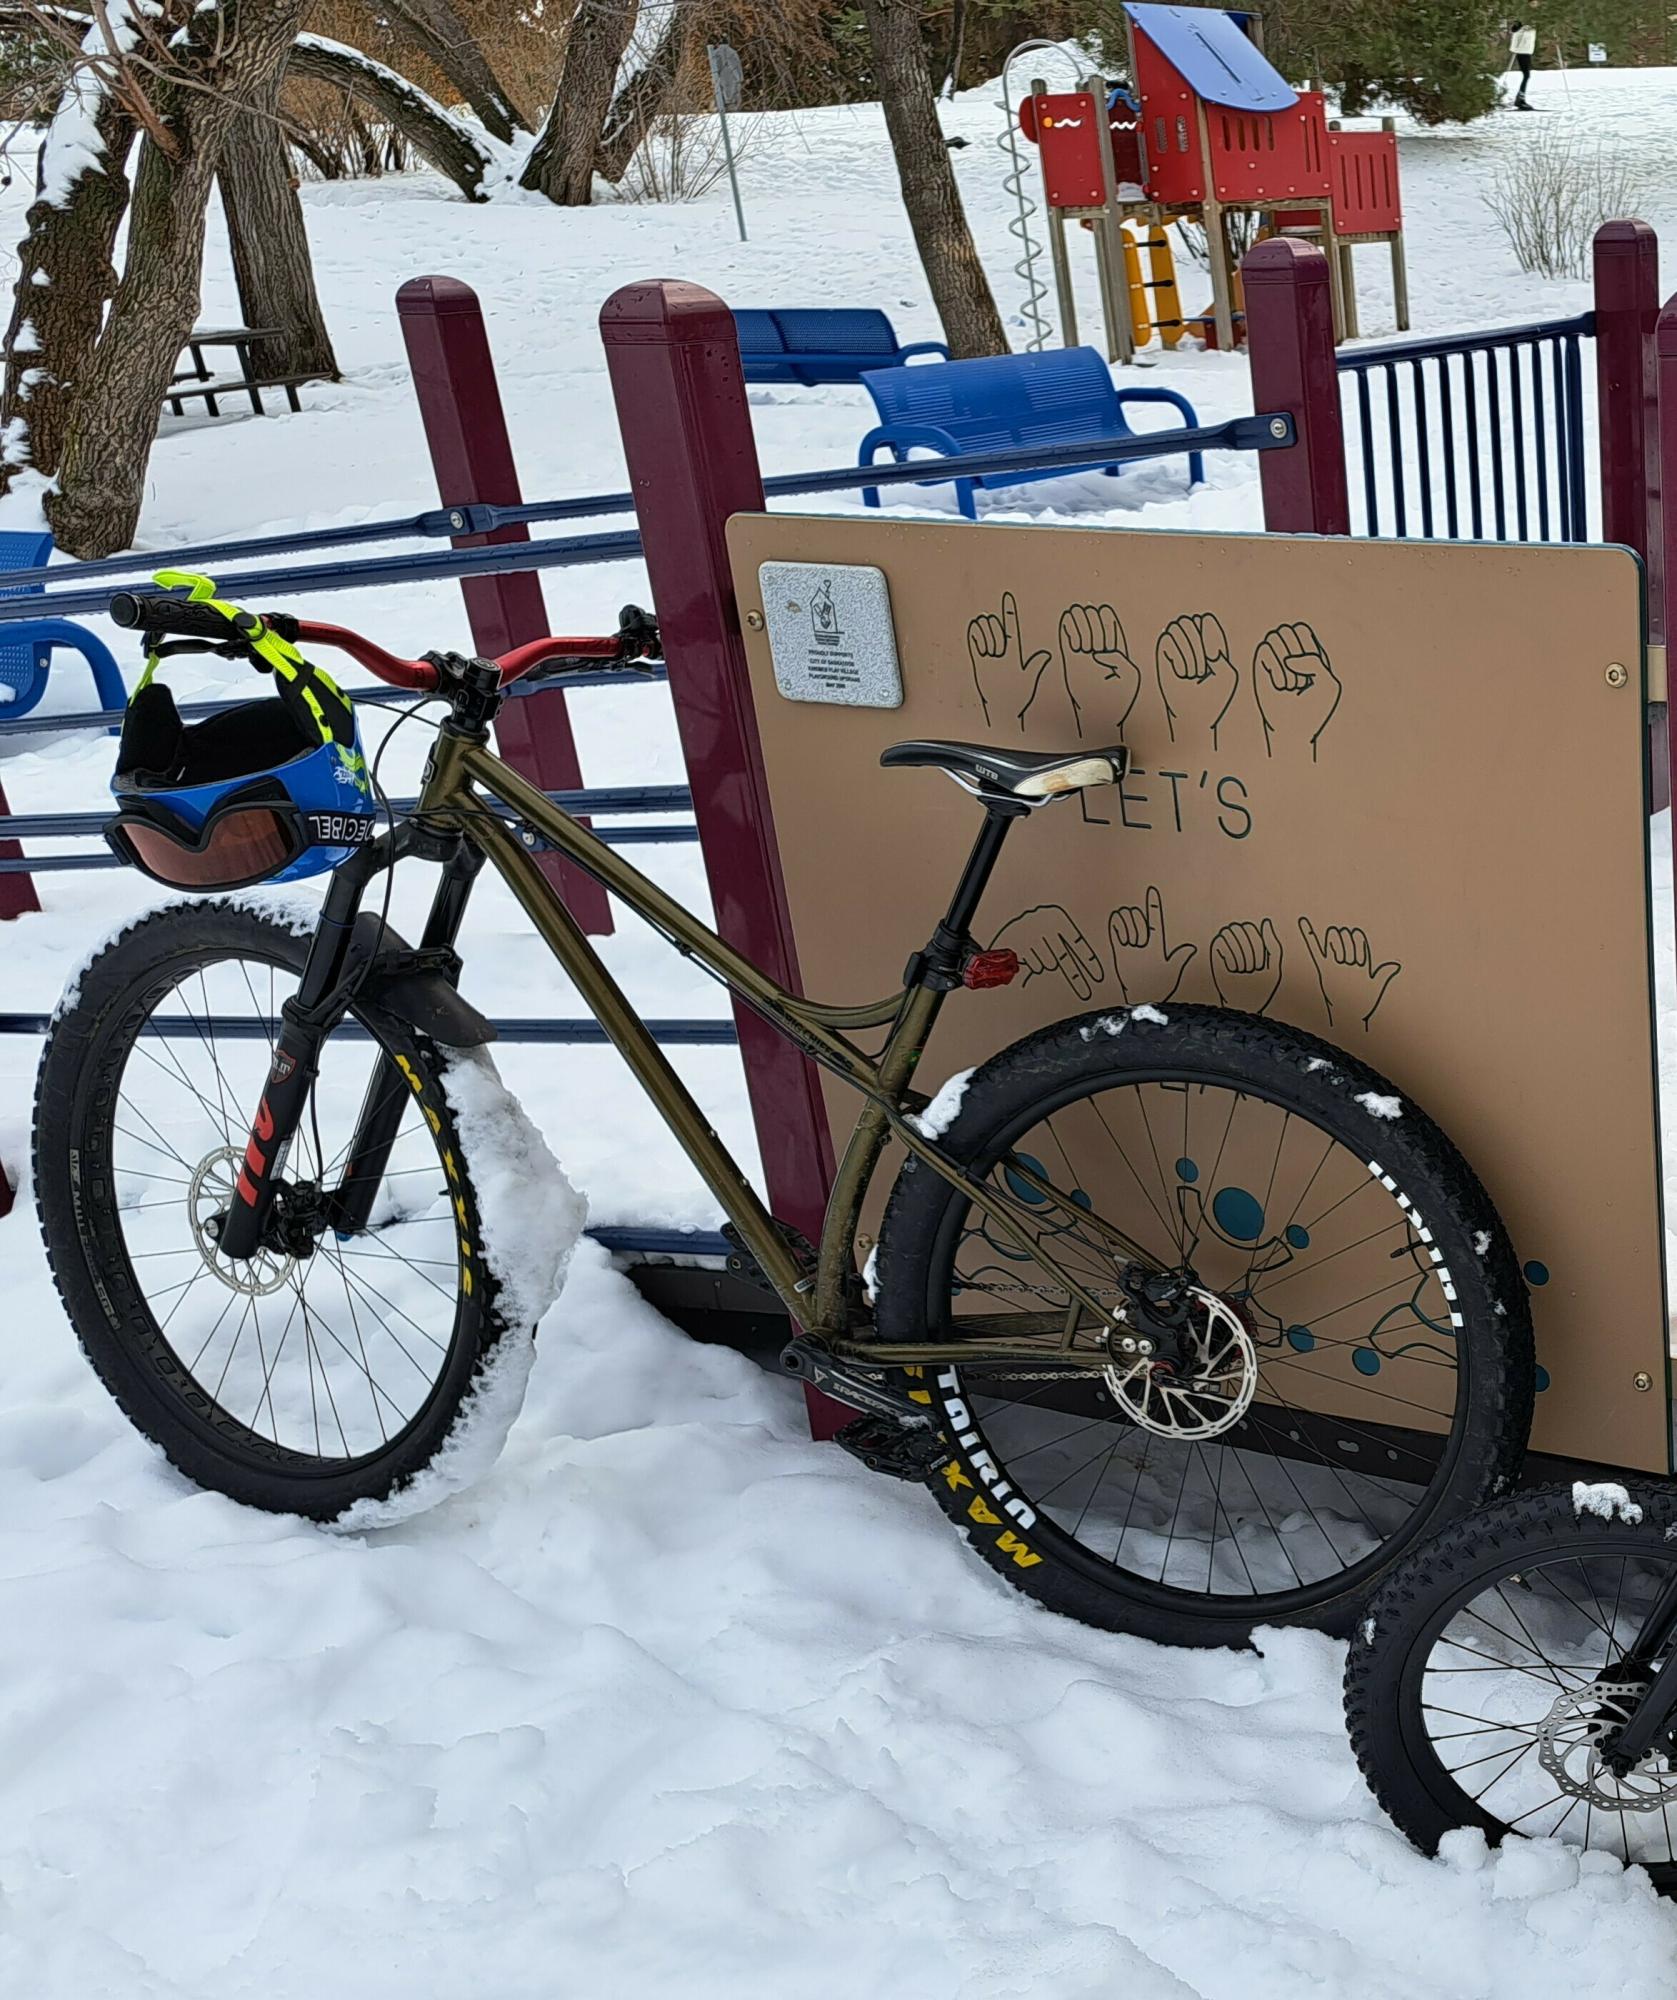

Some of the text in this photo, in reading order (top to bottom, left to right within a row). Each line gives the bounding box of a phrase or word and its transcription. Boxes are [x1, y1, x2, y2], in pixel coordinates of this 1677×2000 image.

[975, 763, 999, 781] WTB
[1079, 768, 1252, 840] LET'S
[308, 815, 375, 841] DECIBEL
